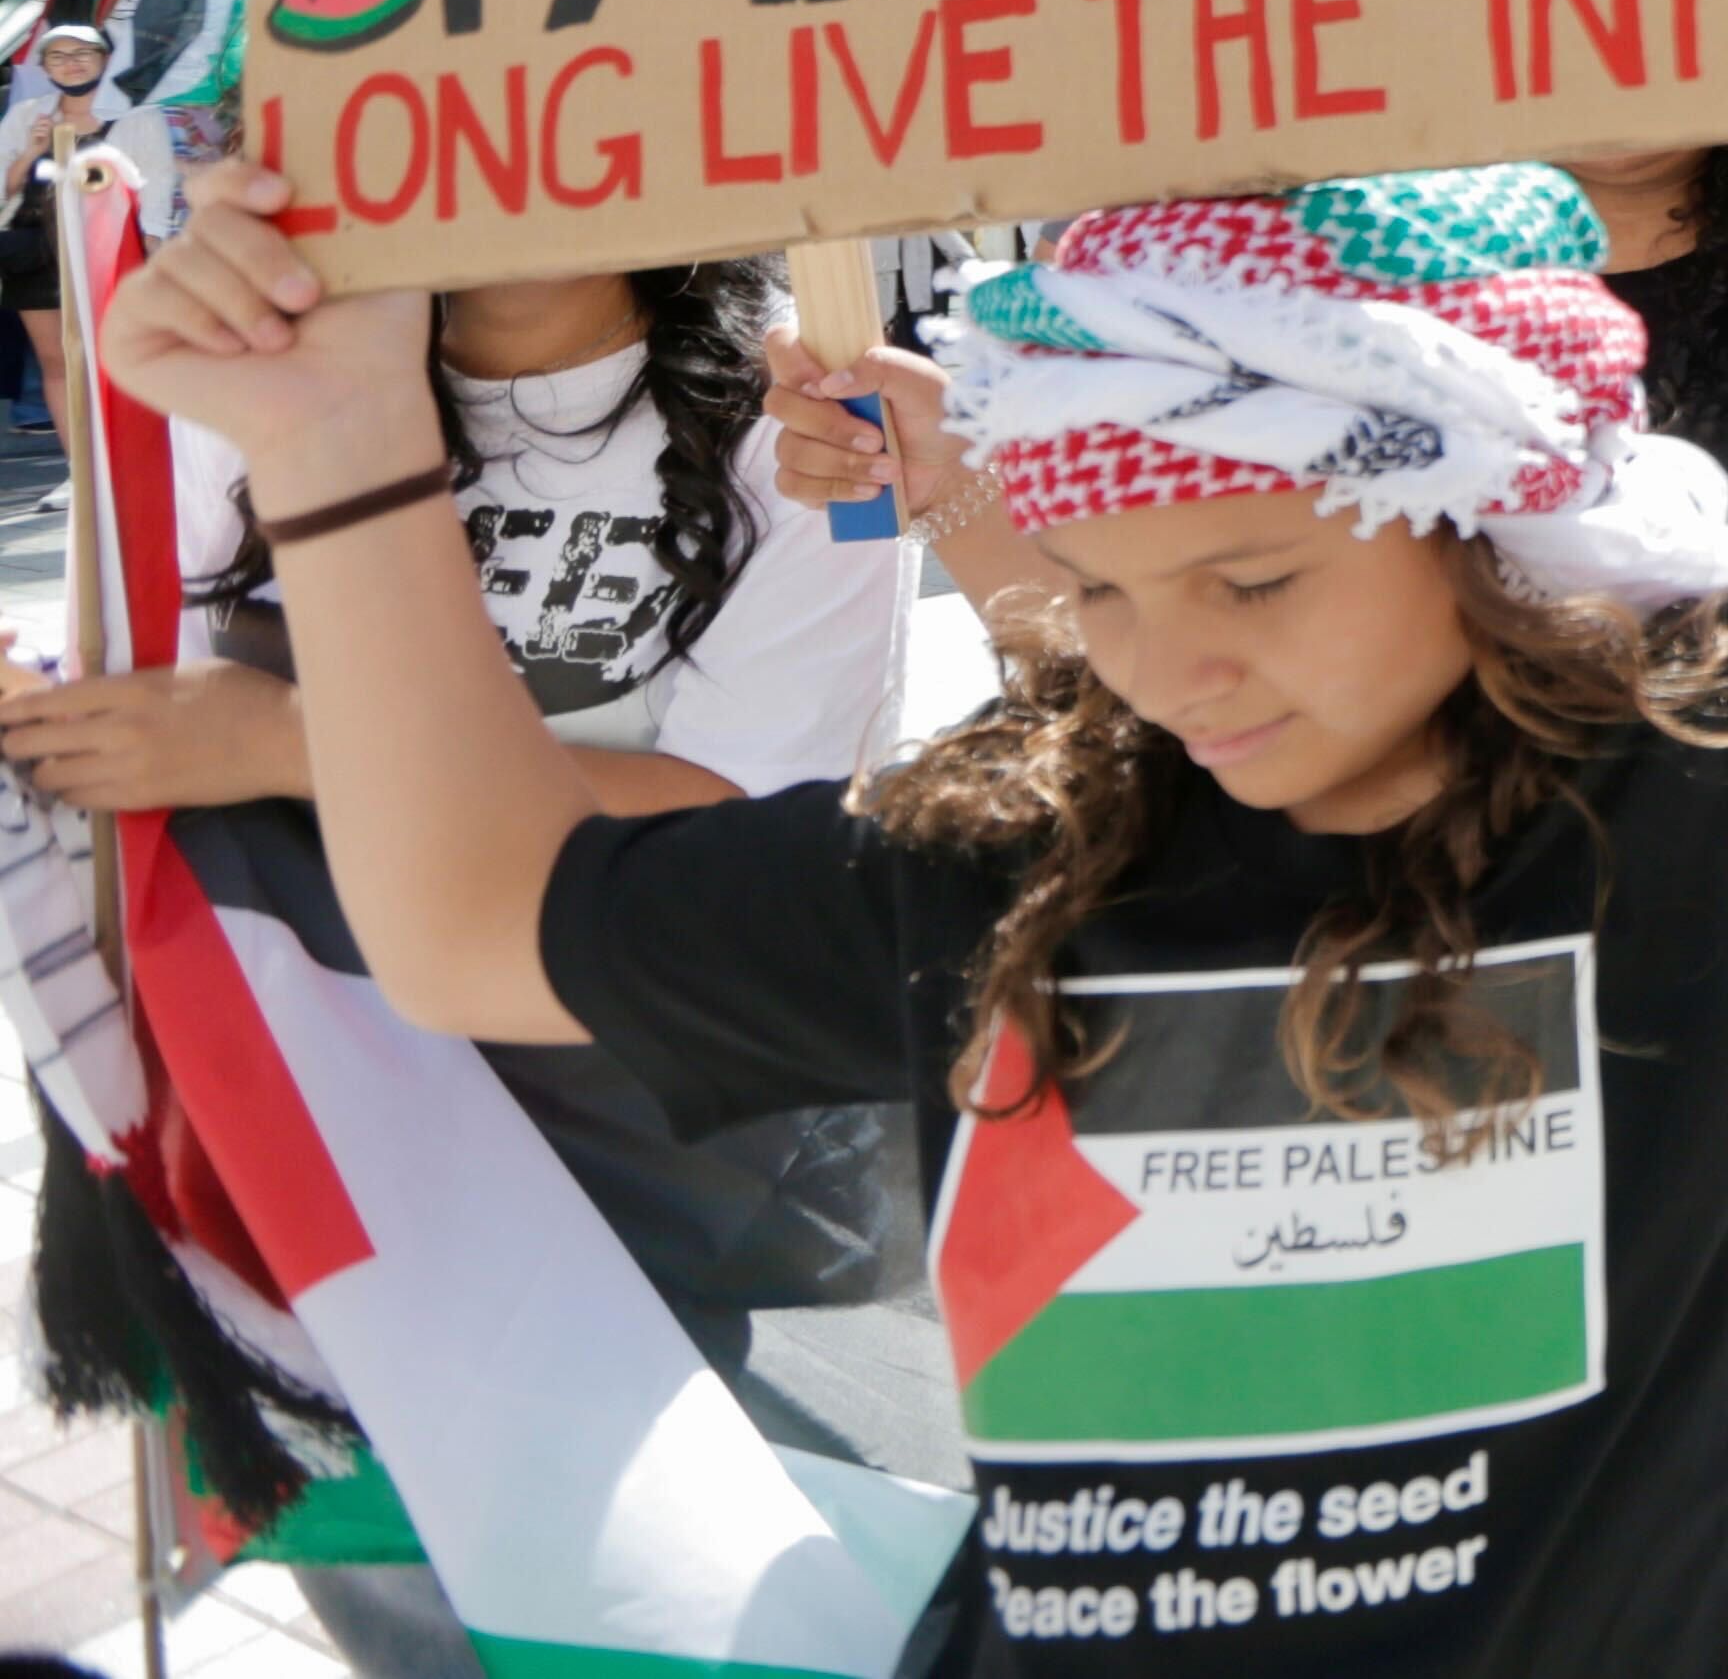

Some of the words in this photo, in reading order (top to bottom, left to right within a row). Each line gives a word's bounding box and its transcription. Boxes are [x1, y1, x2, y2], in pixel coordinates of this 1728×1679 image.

[257, 45, 644, 241] LONG
[1139, 1146, 1264, 1194] FREE
[1281, 1109, 1577, 1187] PALESTINE
[1231, 1190, 1409, 1271] فلسطين
[981, 1483, 1187, 1555] Justice
[1196, 1477, 1305, 1548] the
[1315, 1450, 1489, 1537] seed
[1148, 1567, 1260, 1633] the
[1269, 1533, 1489, 1617] flower
